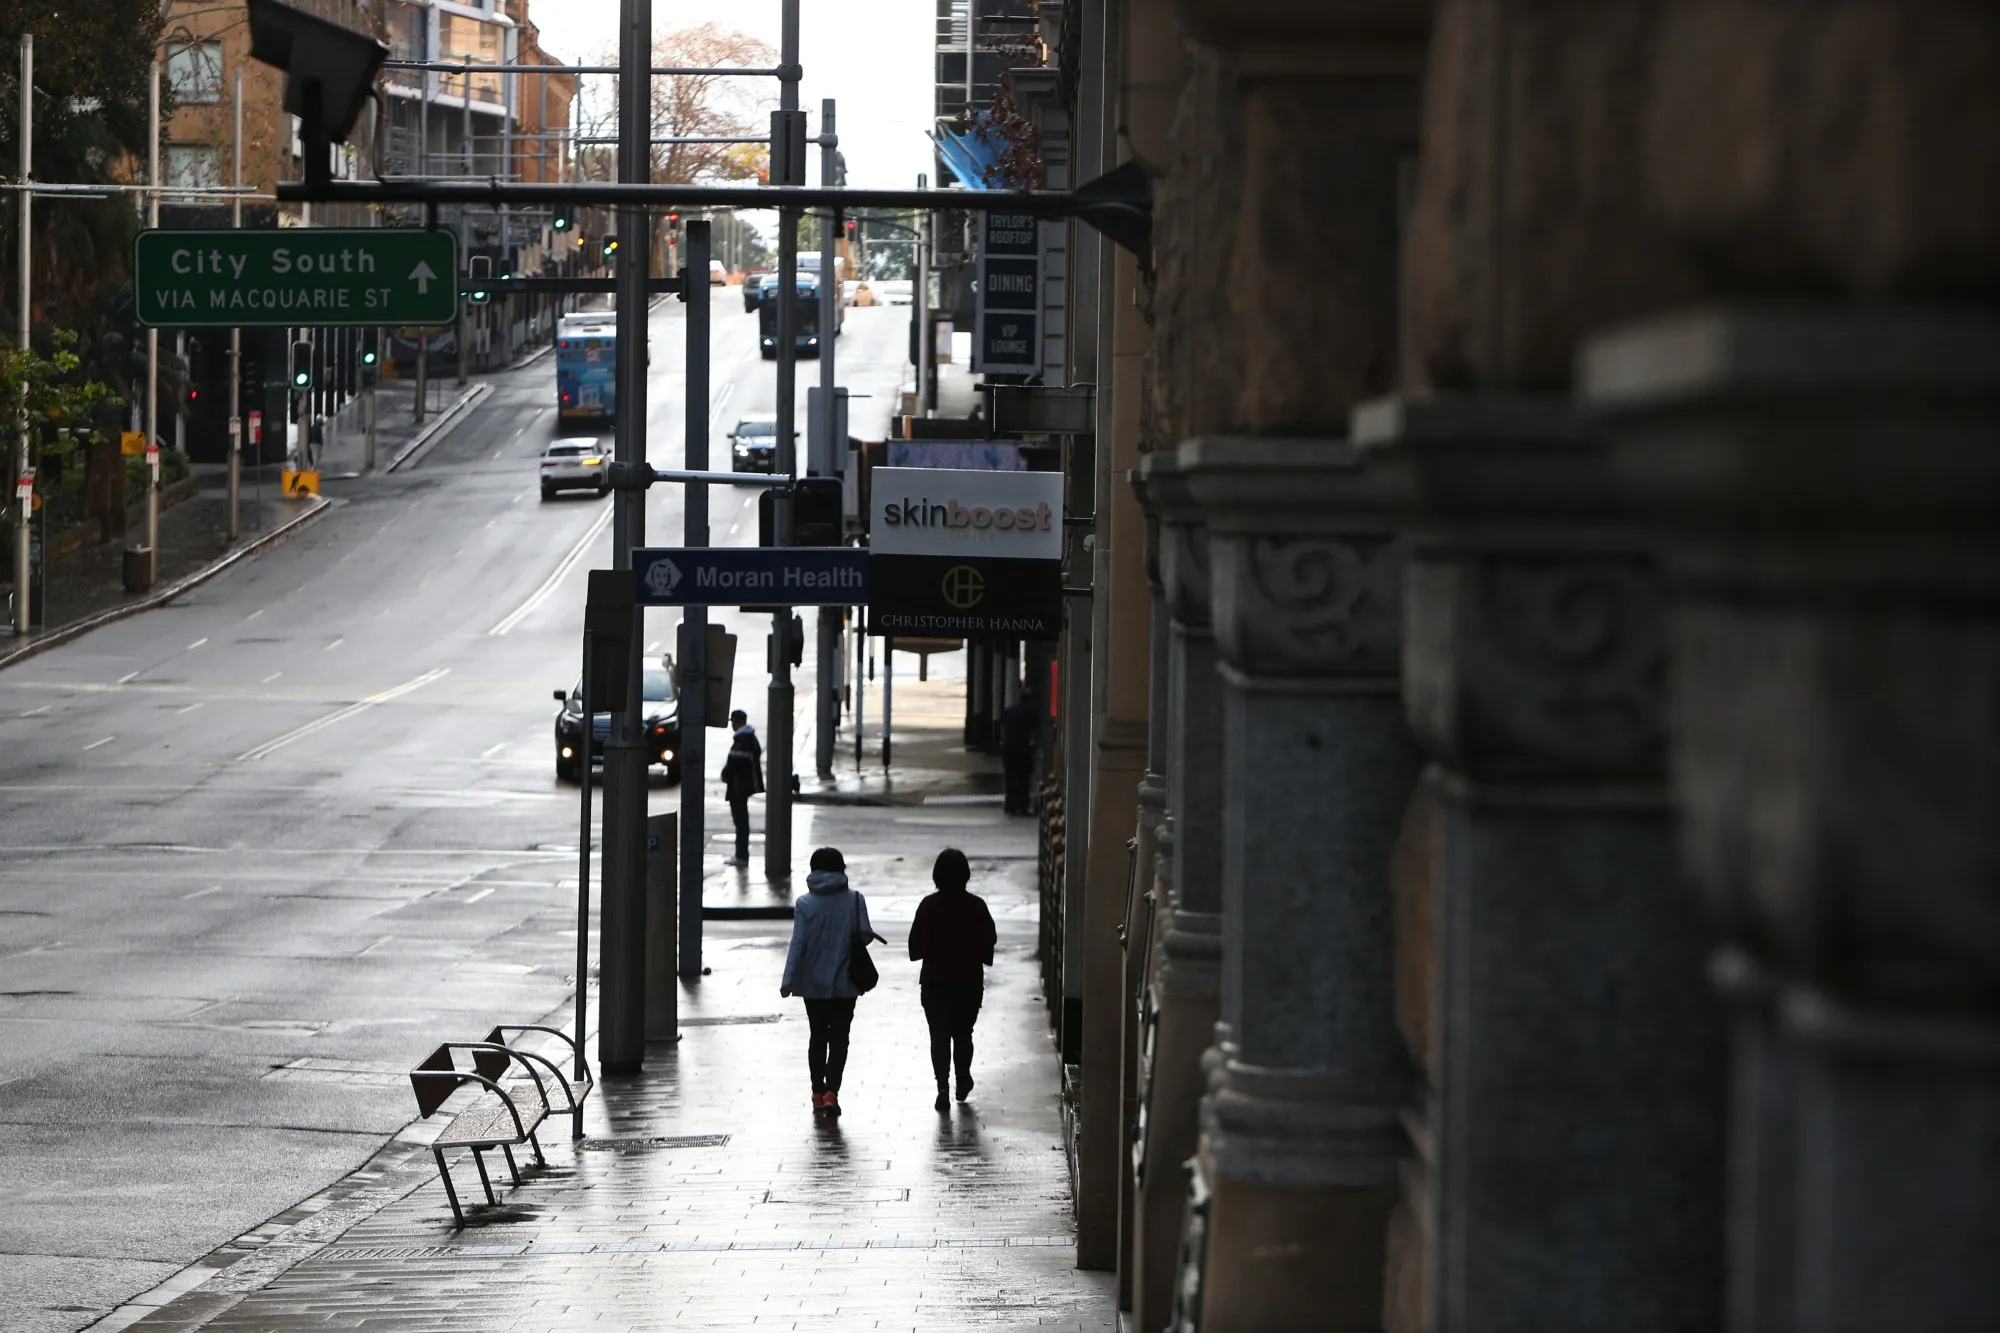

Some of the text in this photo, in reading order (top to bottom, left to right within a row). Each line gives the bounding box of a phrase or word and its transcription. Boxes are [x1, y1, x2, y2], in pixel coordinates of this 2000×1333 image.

[989, 214, 1035, 229] TAYLOR'S
[989, 230, 1034, 244] ROOFTOP
[171, 247, 376, 280] City South
[988, 273, 1034, 292] DINING
[156, 288, 392, 308] VIA MACQUARIE ST
[1001, 324, 1019, 338] VIP
[990, 339, 1028, 354] LOUNGE
[884, 497, 1052, 531] skinboost
[696, 565, 863, 588] Moran Health
[880, 614, 1045, 631] CHRISTOPHER HANNA
